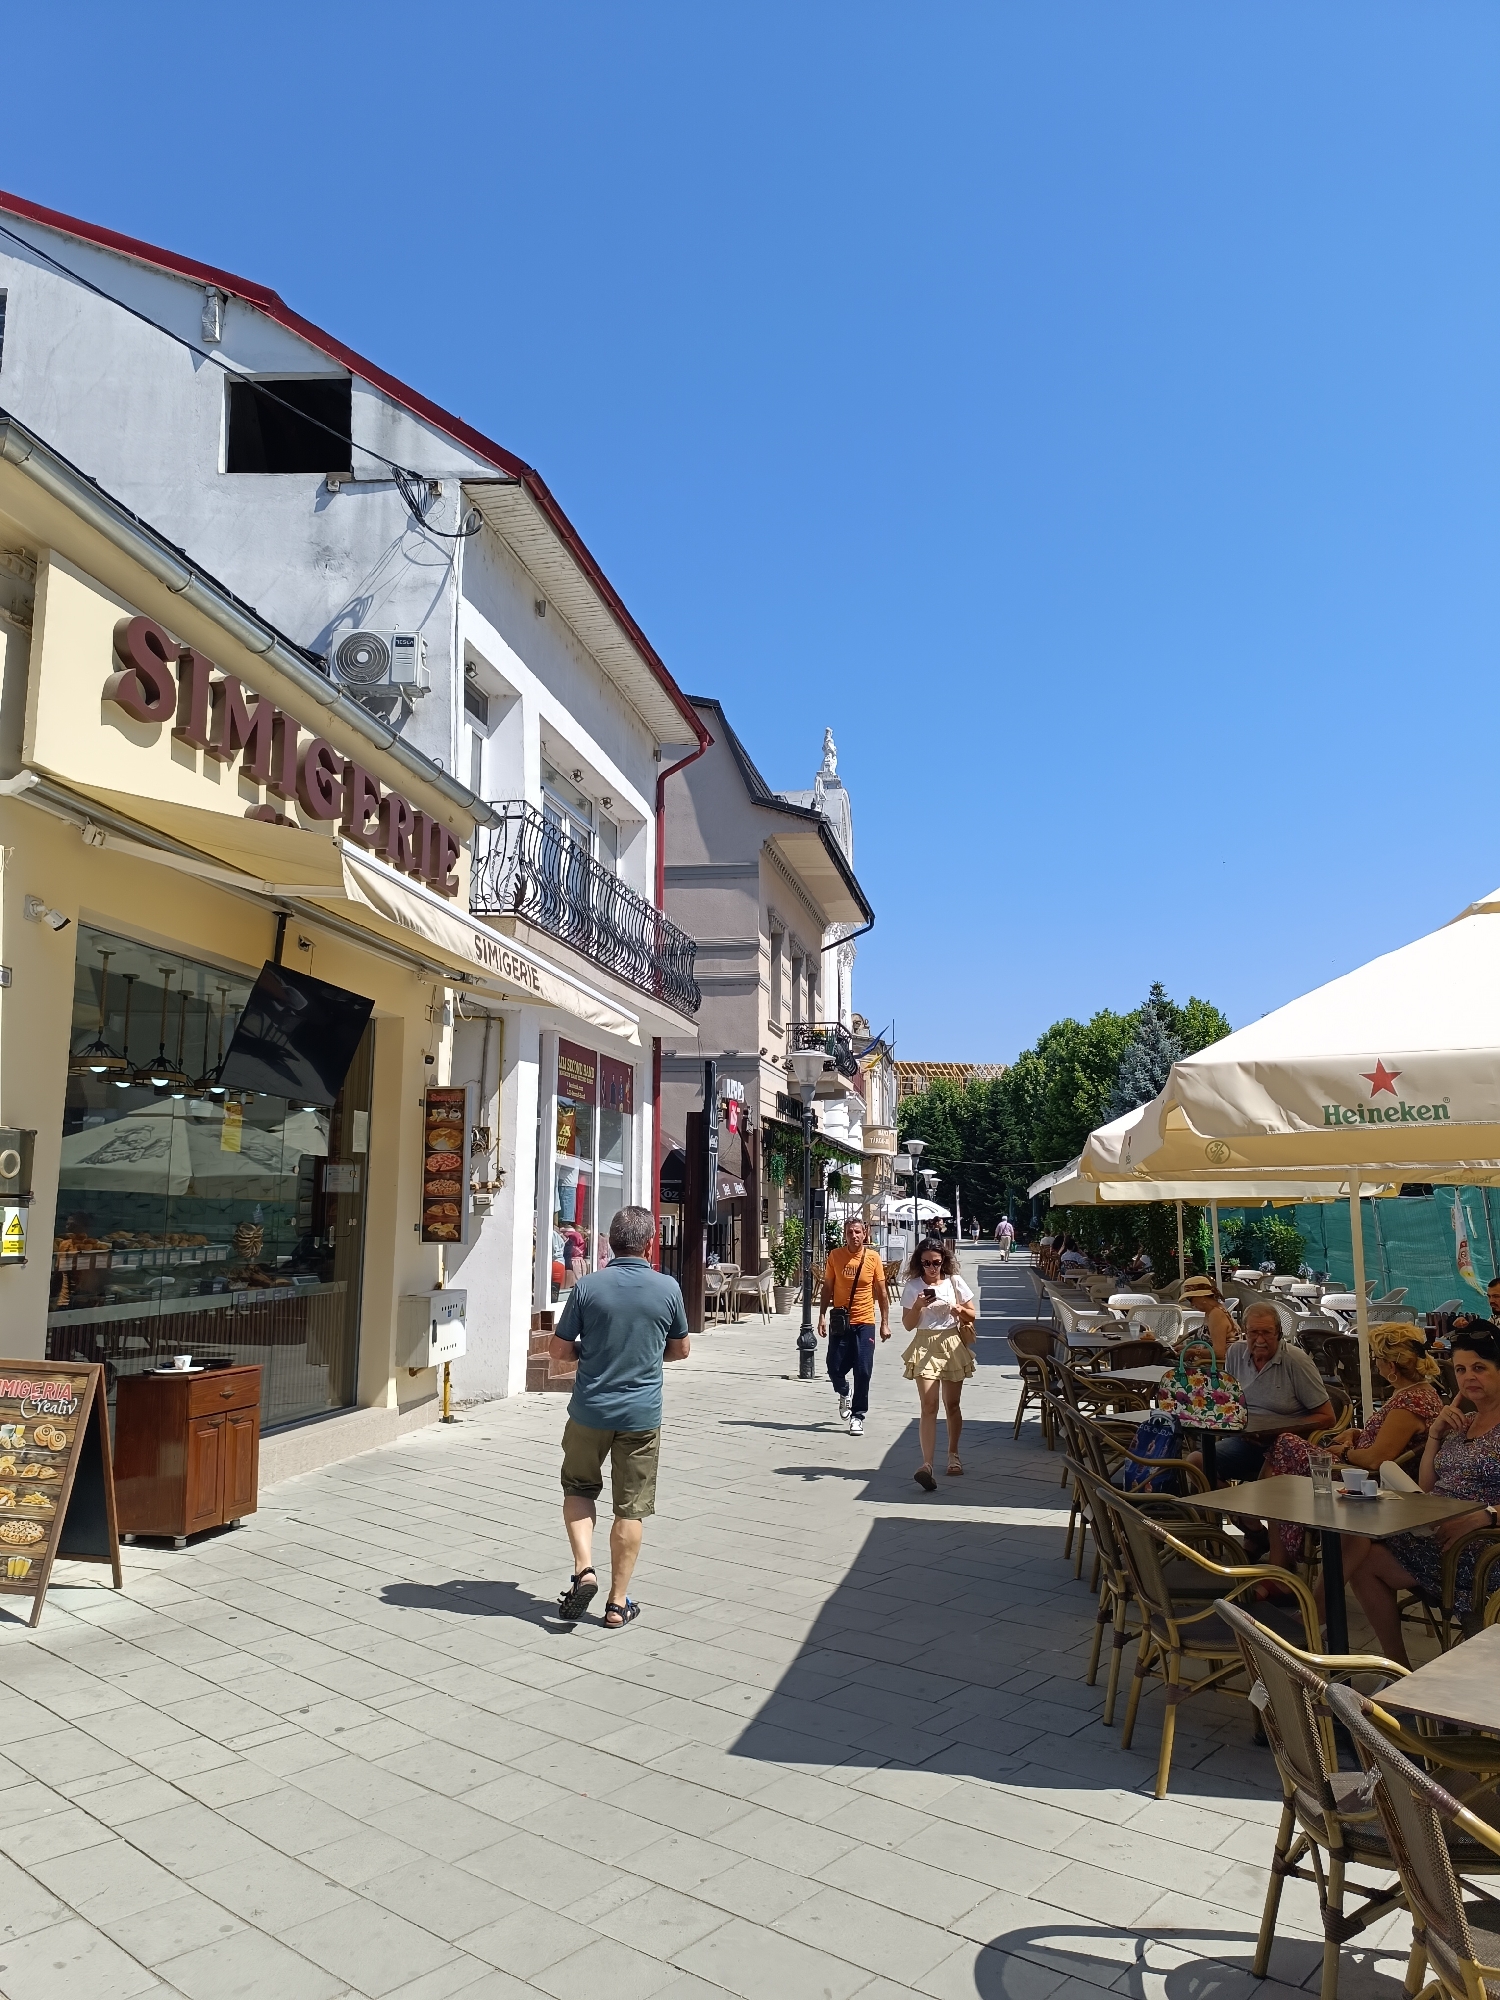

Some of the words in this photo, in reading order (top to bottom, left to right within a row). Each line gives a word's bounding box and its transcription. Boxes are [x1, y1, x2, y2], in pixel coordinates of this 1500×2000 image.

[102, 615, 461, 897] SIMIGERIE
[474, 934, 540, 991] SIMIGERIE
[1322, 1101, 1450, 1125] Heineken
[21, 1393, 78, 1418] Creativ
